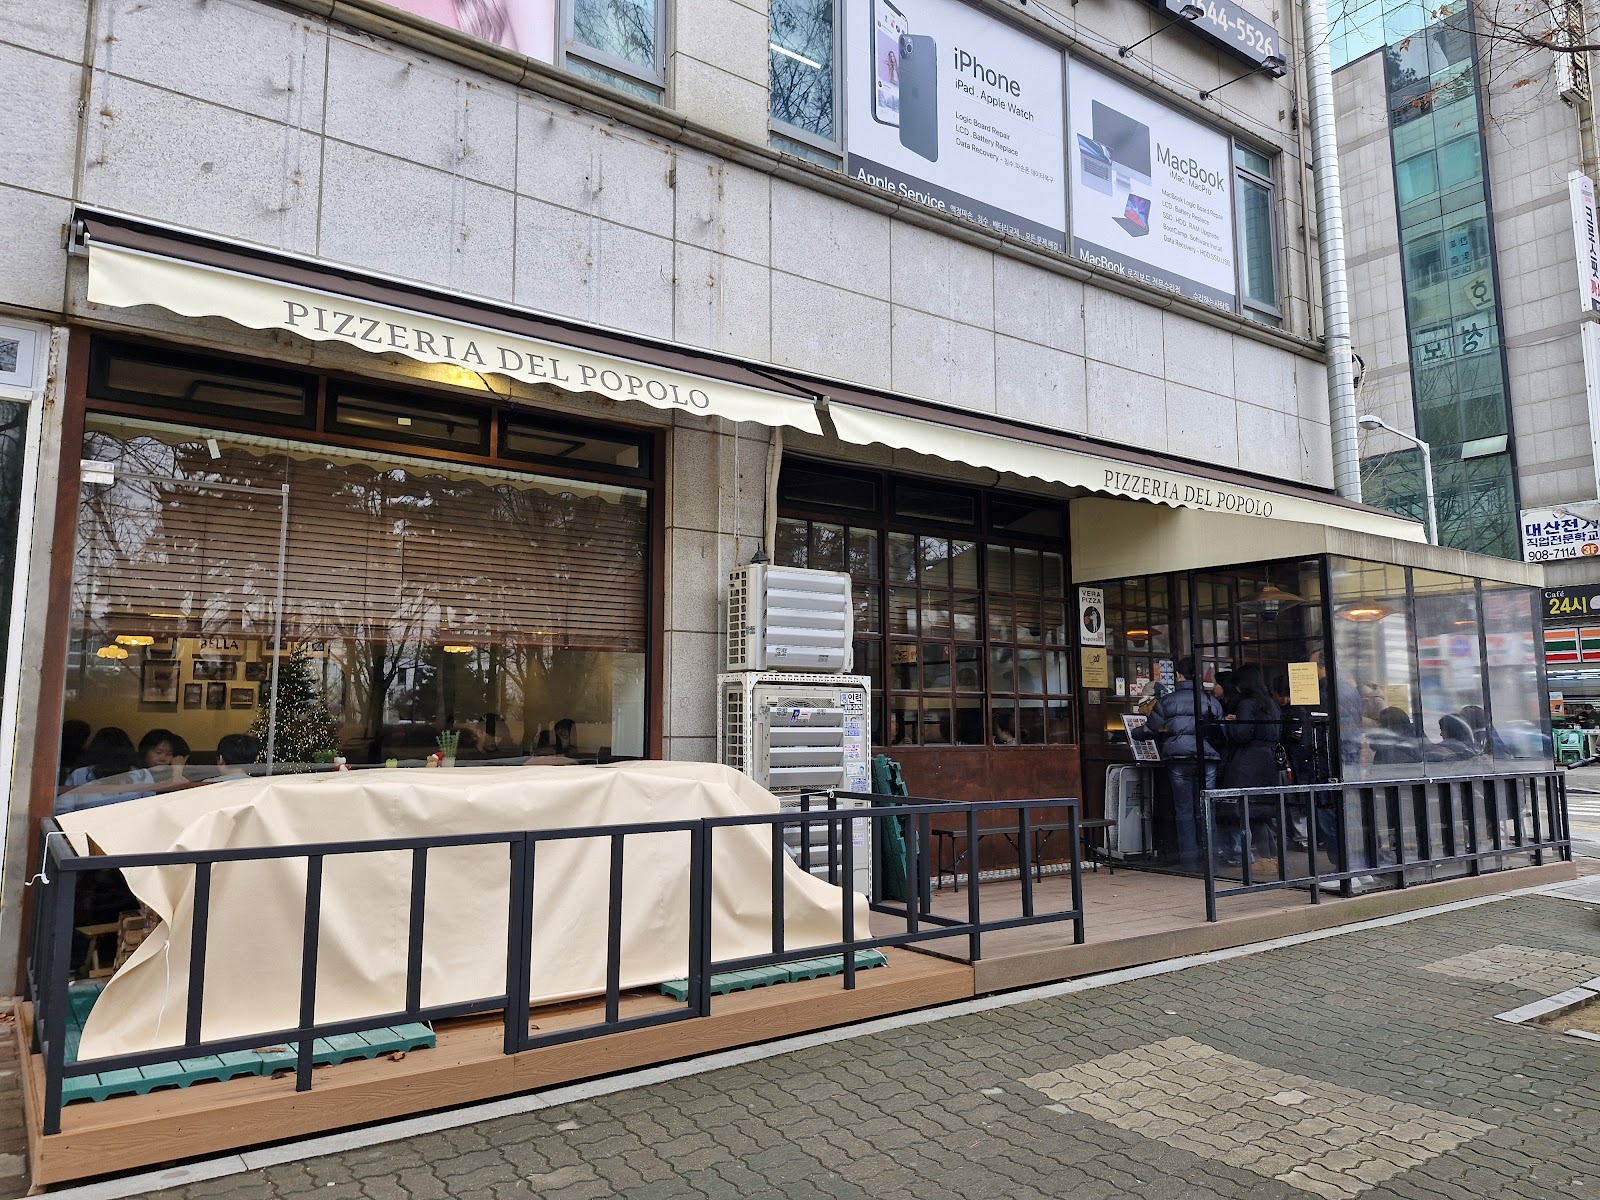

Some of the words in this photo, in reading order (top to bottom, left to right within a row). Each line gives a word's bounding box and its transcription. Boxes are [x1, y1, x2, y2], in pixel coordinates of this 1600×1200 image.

[954, 47, 1021, 98] iPhone
[955, 78, 975, 96] iPad
[980, 90, 1006, 110] Apple
[1007, 100, 1035, 122] Watch
[955, 111, 973, 125] Logic
[973, 118, 991, 132] Board
[991, 126, 1011, 141] Repair
[955, 124, 970, 136] LCD
[972, 131, 994, 148] Battery
[995, 140, 1019, 157] Replace
[955, 137, 971, 150] Data
[971, 144, 999, 162] Recovery
[1156, 142, 1225, 192] MacBook
[857, 167, 896, 194] Apple
[898, 182, 945, 210] Service
[1169, 169, 1185, 184] iMac
[1188, 179, 1212, 196] MacPro
[1079, 248, 1126, 276] MacBook
[1470, 279, 1492, 308] 호
[283, 300, 486, 366] PIZZERIA
[496, 346, 570, 382] DEL
[579, 364, 710, 409] POPOLO
[1103, 469, 1180, 501] PIZZERIA
[1184, 485, 1213, 507] DEL
[1216, 491, 1273, 518] POPOLO
[1526, 530, 1600, 548] 직업전문학교
[1528, 546, 1577, 561] 908-7114
[1584, 545, 1597, 555] 3F
[1081, 590, 1102, 598] VERA
[1544, 590, 1565, 599] Café
[1549, 596, 1588, 615] 24시
[200, 639, 239, 650] BELLA
[847, 693, 862, 704] 인력
